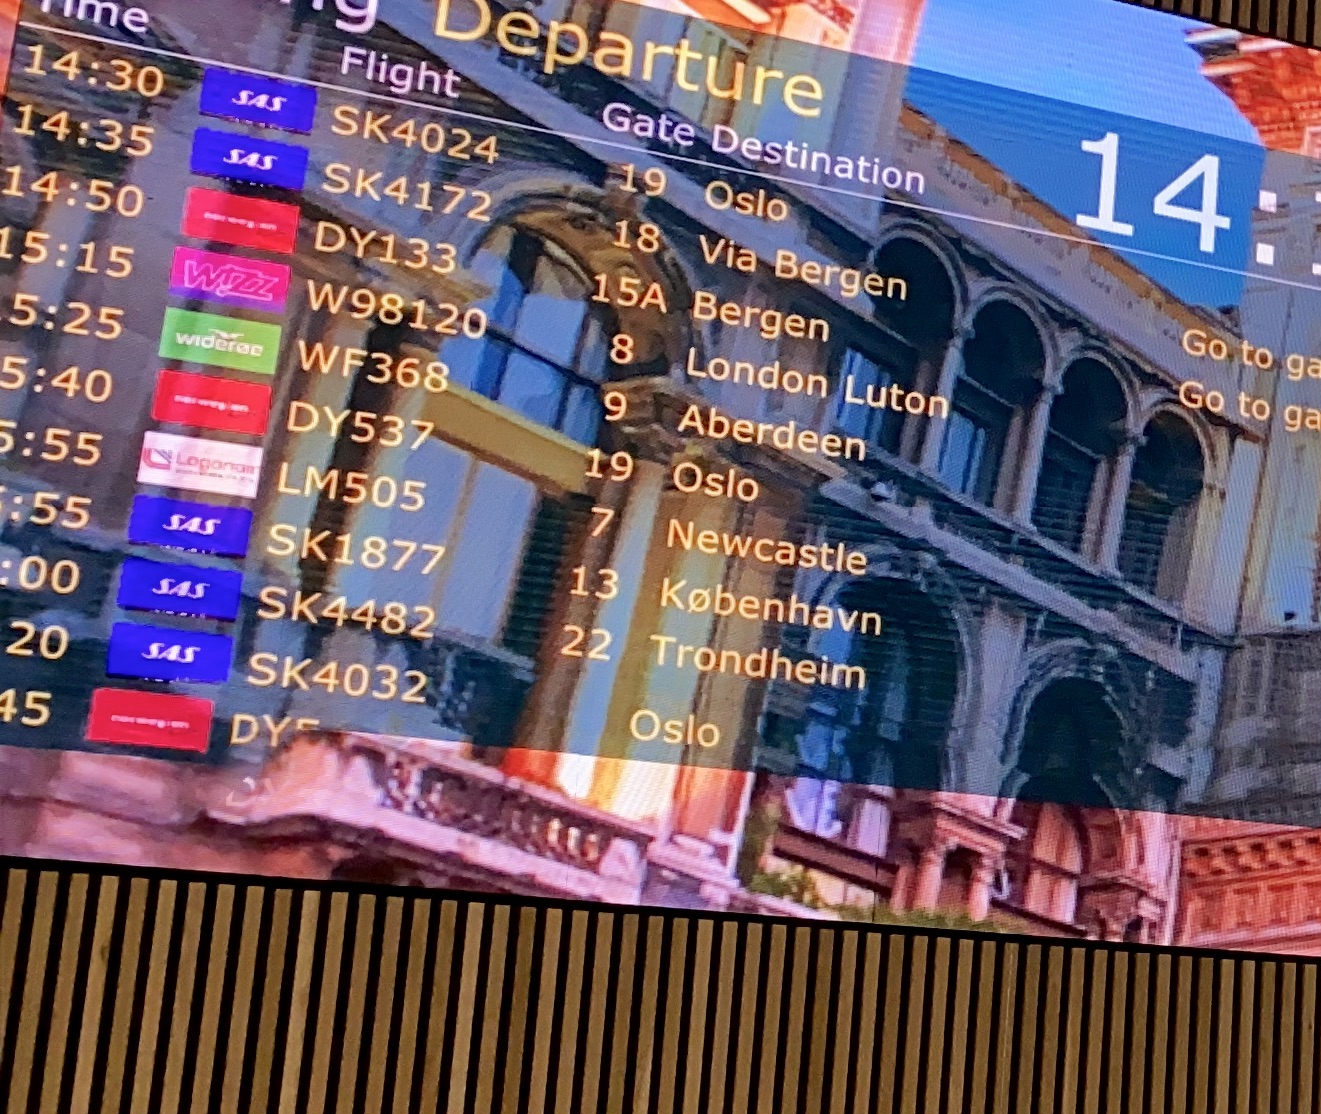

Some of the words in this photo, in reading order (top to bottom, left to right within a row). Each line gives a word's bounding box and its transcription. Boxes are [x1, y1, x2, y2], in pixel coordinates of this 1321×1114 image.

[340, 45, 461, 99] Flight
[602, 101, 696, 149] Gate
[712, 125, 924, 195] Destination
[433, 0, 824, 118] Departure
[25, 43, 164, 97] 14:30
[232, 89, 287, 113] SAS
[331, 105, 499, 164] SK4024
[617, 163, 668, 197] 19
[704, 180, 789, 222] Oslo
[2, 165, 145, 217] 14:50
[314, 220, 459, 274] DY133
[591, 274, 668, 314] 15A
[693, 292, 830, 343] Bergen
[1178, 381, 1225, 412] Go
[1238, 391, 1271, 421] to
[14, 104, 155, 158] 14:35
[223, 148, 279, 171] SAS
[323, 164, 493, 222] SK4172
[613, 220, 660, 253] 18
[699, 234, 757, 272] Via
[774, 250, 907, 301] Bergen
[1182, 329, 1227, 360] Go
[1241, 340, 1273, 370] to
[0, 227, 135, 279] 15:15
[306, 278, 487, 340] W98120
[610, 334, 635, 365] 8
[687, 345, 828, 399] London
[845, 372, 950, 420] Luton
[0, 293, 125, 340] 5:25
[298, 339, 449, 393] WF368
[603, 391, 628, 422] 9
[678, 403, 868, 463] Aberdeen
[277, 460, 427, 513] LM505
[591, 507, 615, 538] 7
[666, 520, 868, 577] Newcastle
[287, 401, 434, 450] DY537
[585, 451, 634, 483] 19
[672, 461, 760, 503] Oslo
[152, 577, 210, 599] SAS
[257, 587, 436, 641] SK4482
[560, 625, 612, 661] 22
[650, 635, 867, 691] Trondheim
[162, 513, 221, 535] SAS
[266, 523, 446, 577] SK1877
[569, 567, 620, 600] 13
[660, 578, 882, 638] København
[141, 642, 201, 664] SAS
[247, 652, 427, 704] SK4032
[629, 708, 721, 749] Oslo
